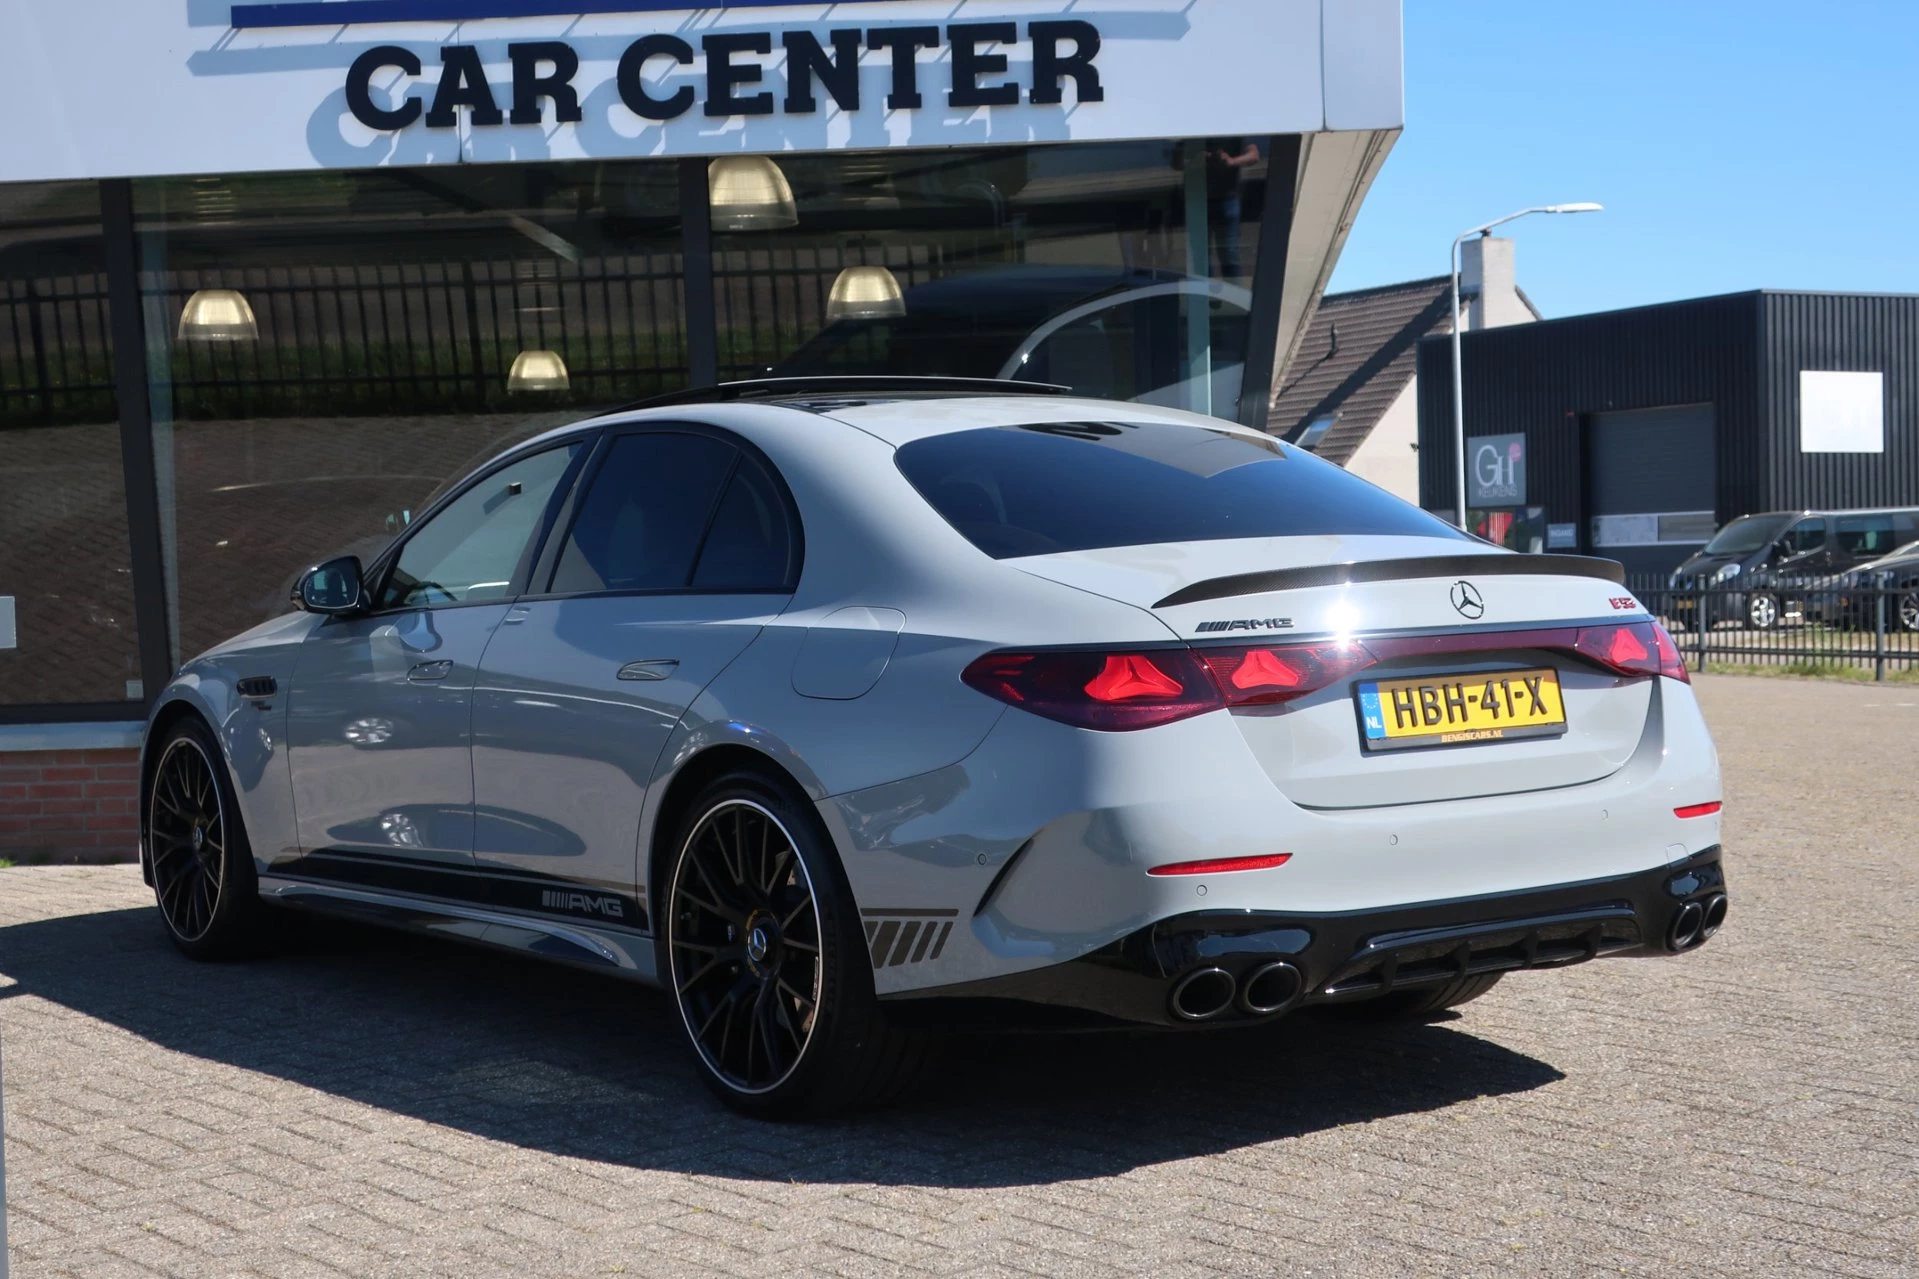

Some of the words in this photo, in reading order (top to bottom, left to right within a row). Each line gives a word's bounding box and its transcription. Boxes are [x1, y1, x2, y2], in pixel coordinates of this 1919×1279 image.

[345, 41, 583, 131] CAR
[616, 20, 1104, 120] CENTER
[1227, 617, 1294, 631] AMG
[1391, 676, 1548, 729] HBH-41-X
[1366, 716, 1383, 729] NL
[568, 893, 624, 917] AMG
